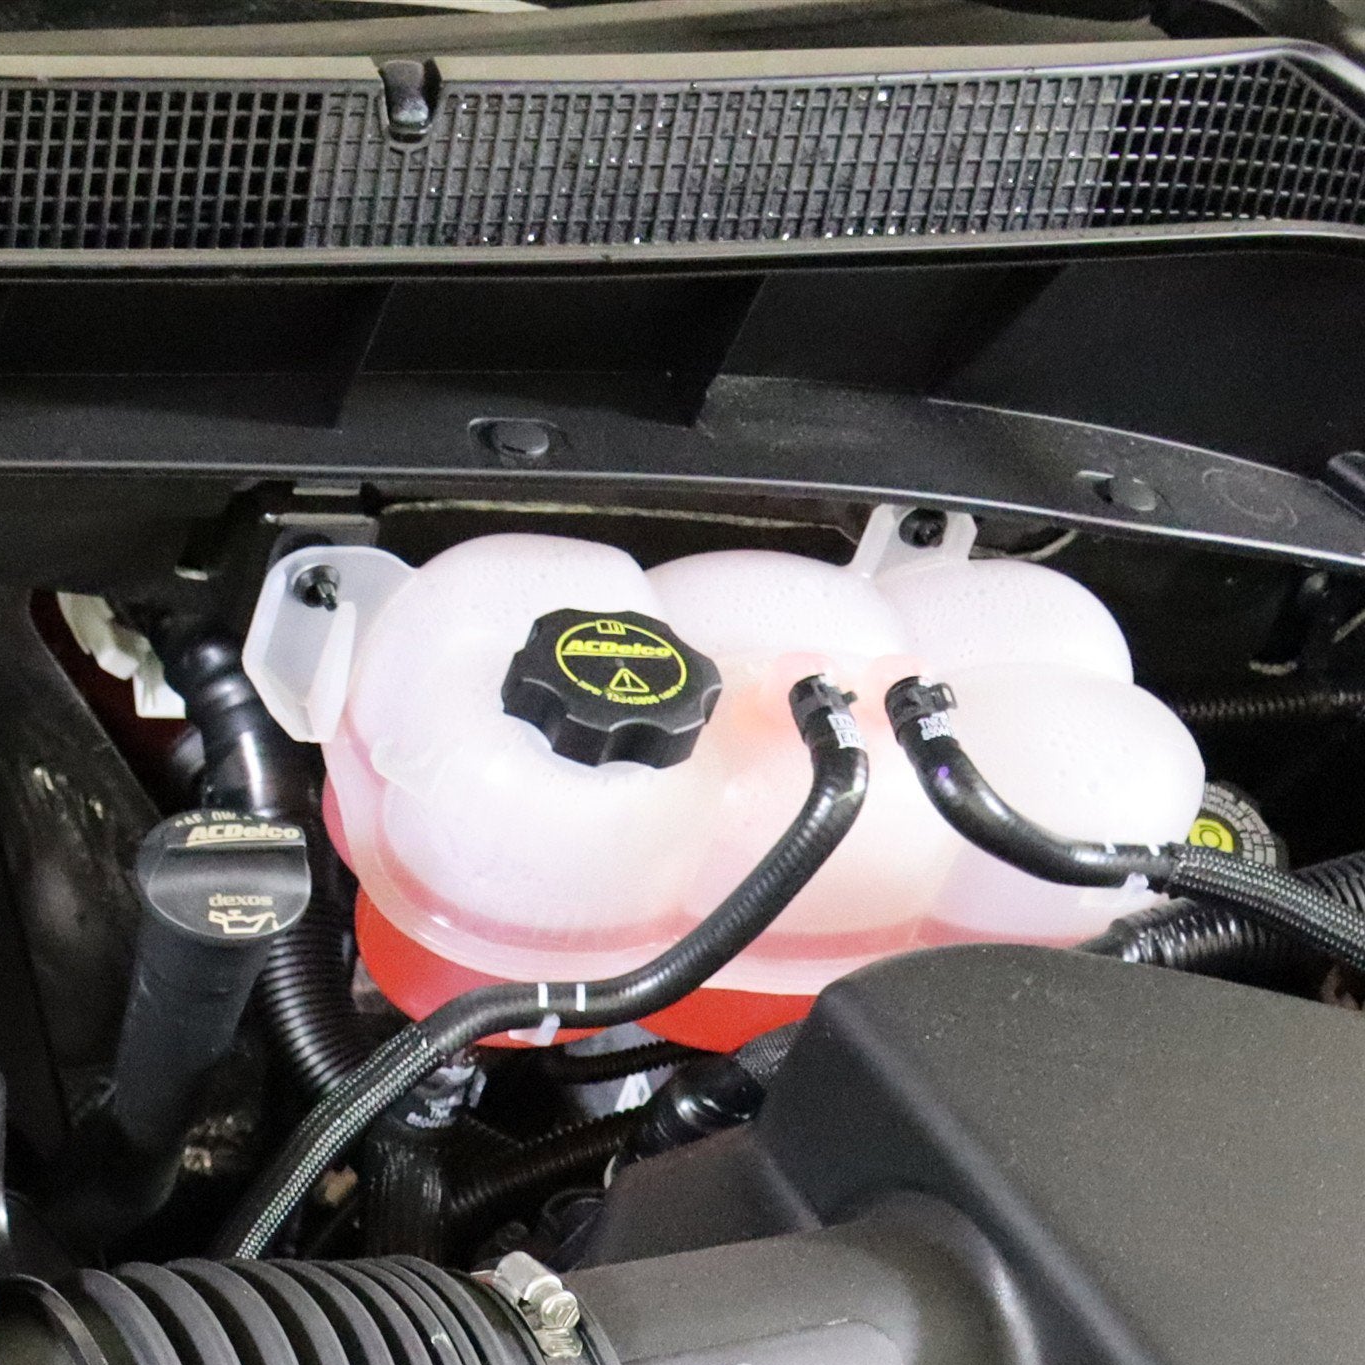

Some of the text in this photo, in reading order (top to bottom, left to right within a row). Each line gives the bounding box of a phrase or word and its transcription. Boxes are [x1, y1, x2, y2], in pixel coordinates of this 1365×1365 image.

[563, 639, 673, 657] ACDelco
[186, 823, 301, 842] ACDelco
[209, 893, 273, 907] dexos
